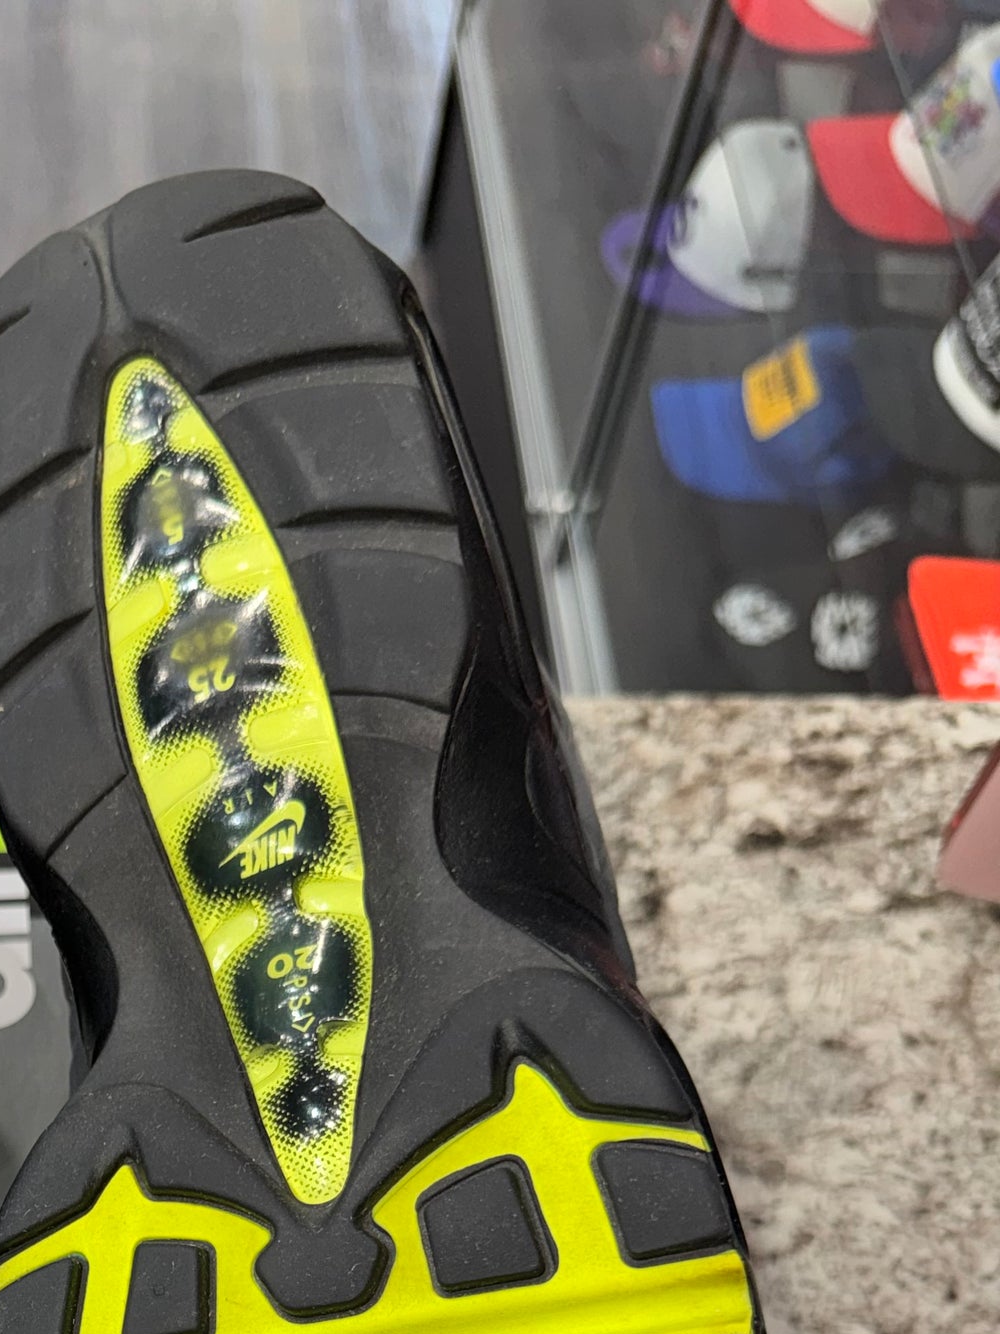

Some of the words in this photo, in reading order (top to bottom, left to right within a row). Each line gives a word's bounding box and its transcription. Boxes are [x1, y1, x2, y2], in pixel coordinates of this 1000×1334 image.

[187, 655, 237, 704] 25
[222, 780, 278, 815] AIR
[239, 823, 297, 880] NIKE
[266, 943, 319, 980] 20
[282, 976, 314, 1023] PSI
